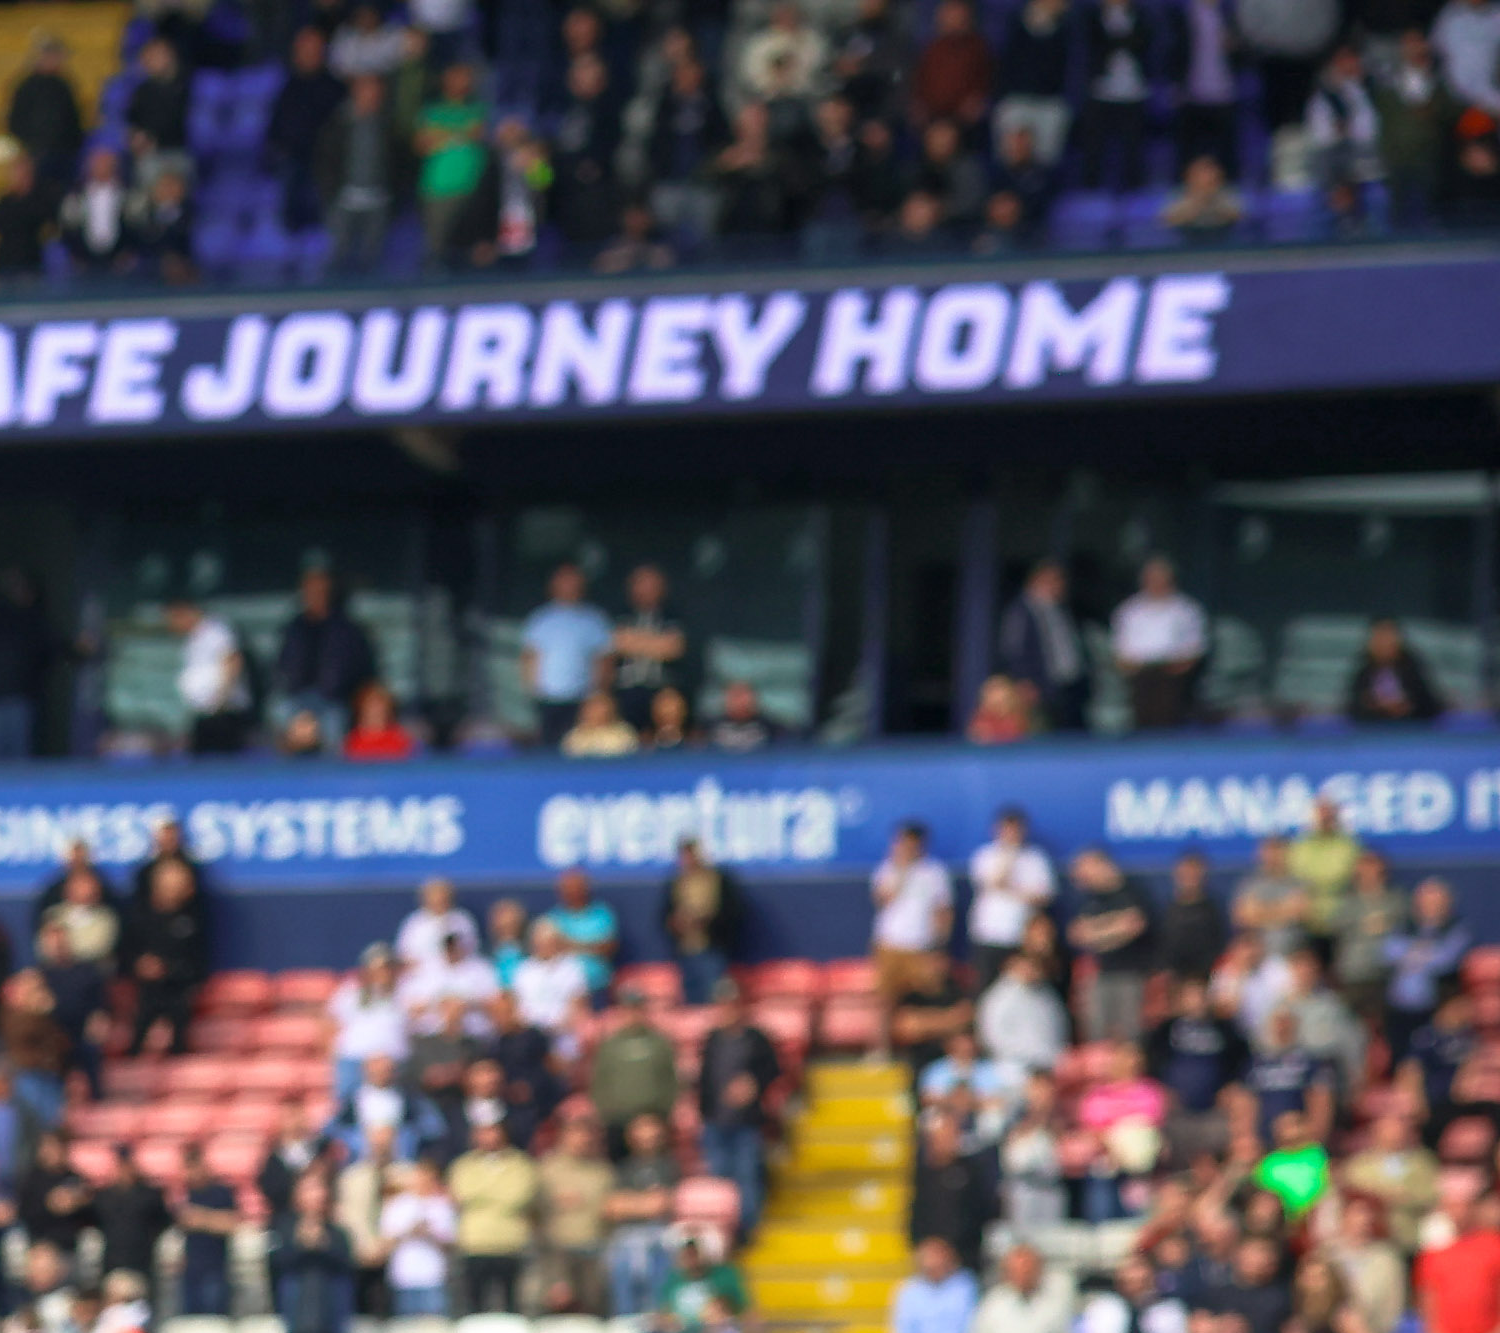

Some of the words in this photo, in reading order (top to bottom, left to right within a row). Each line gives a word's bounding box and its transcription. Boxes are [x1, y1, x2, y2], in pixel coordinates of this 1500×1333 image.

[181, 294, 804, 419] JOURNEY
[812, 275, 1230, 395] HOME
[187, 796, 466, 862] SYSTEMS
[537, 778, 838, 868] eventura
